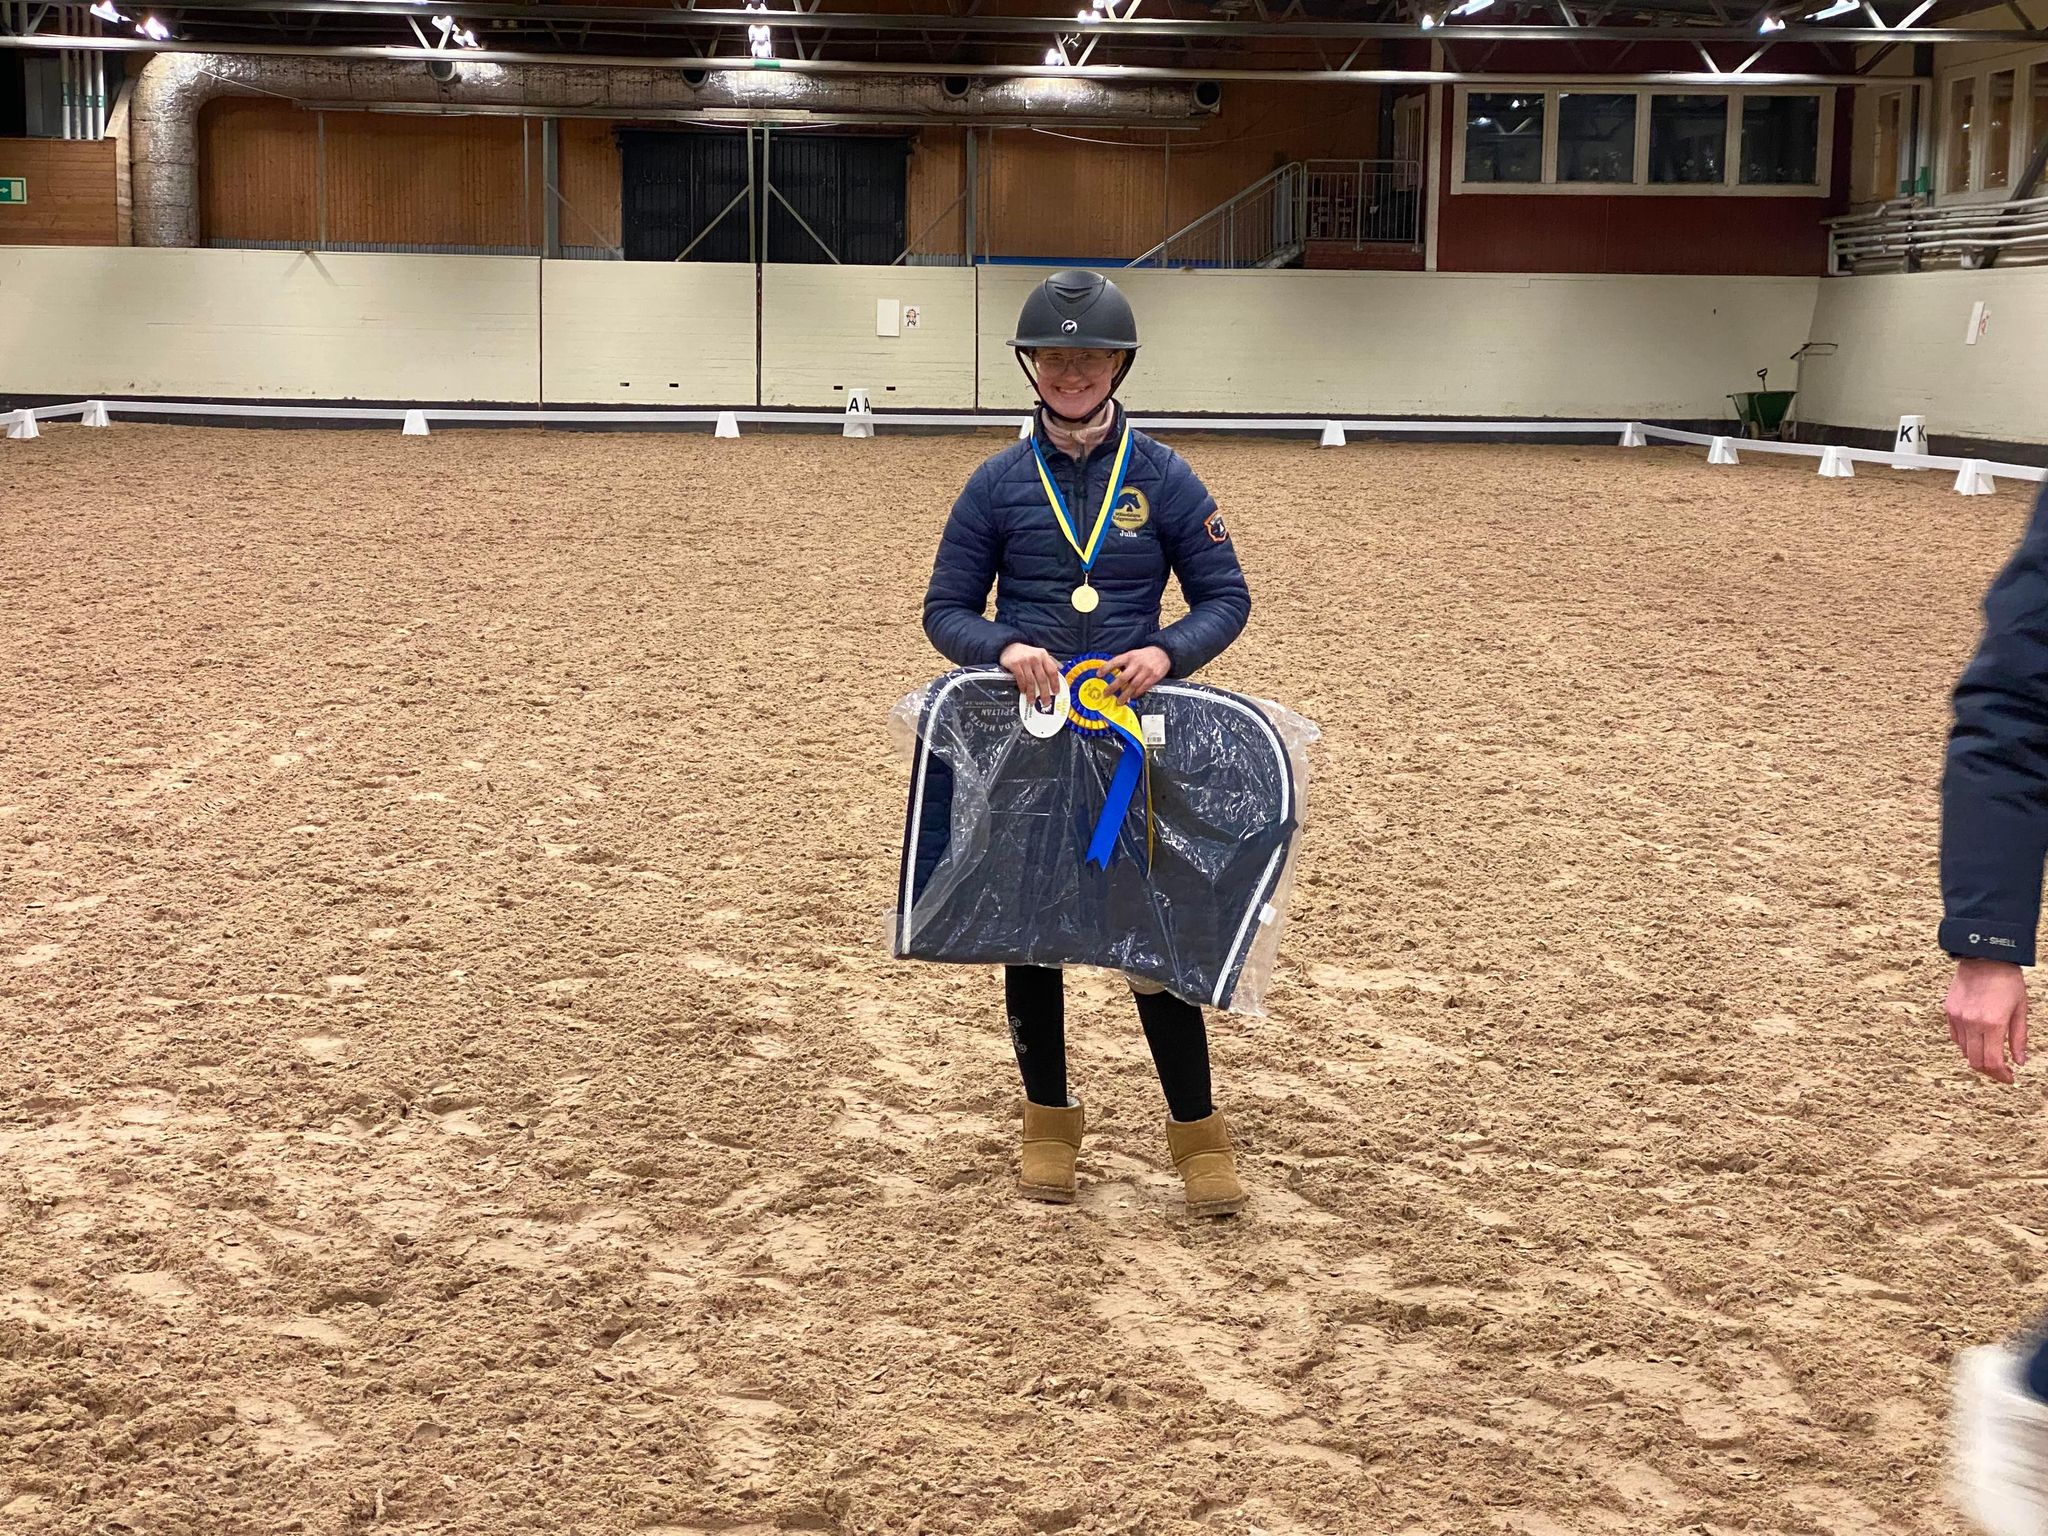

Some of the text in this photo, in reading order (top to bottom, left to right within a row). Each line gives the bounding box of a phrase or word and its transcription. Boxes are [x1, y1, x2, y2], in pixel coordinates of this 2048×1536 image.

[848, 397, 860, 412] A
[864, 397, 870, 412] A
[1899, 426, 1914, 442] K
[1918, 425, 1926, 442] K
[1119, 530, 1137, 538] Julia
